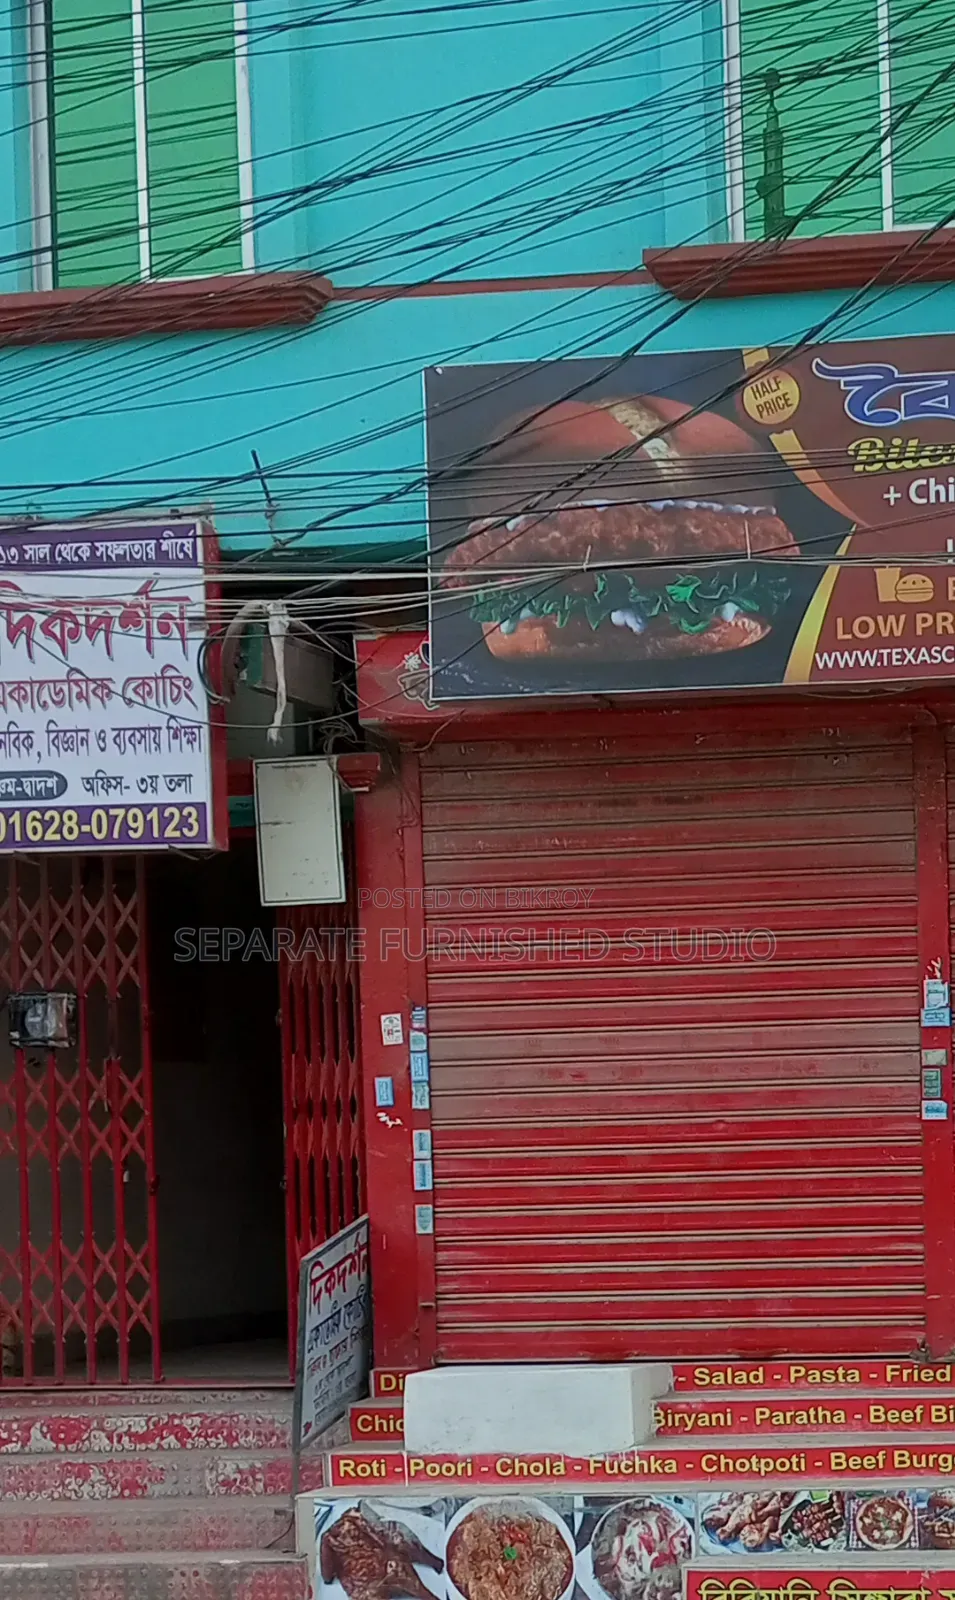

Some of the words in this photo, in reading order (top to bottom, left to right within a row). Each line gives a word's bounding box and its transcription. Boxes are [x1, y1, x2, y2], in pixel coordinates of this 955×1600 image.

[750, 374, 783, 401] HALF
[755, 396, 794, 420] PRICE
[22, 543, 51, 564] সাল
[55, 541, 92, 564] থেকে
[94, 539, 157, 562] সফলতার
[836, 614, 905, 640] LOW
[915, 611, 955, 636] PR
[121, 663, 198, 711] কোচিং
[45, 718, 91, 759] বিজ্ঞান
[95, 729, 107, 753] ও
[165, 714, 203, 754] শিক্ষা
[136, 774, 159, 796] ৩য়
[163, 773, 194, 794] তলা
[693, 1367, 764, 1386] Salad
[788, 1365, 861, 1384] Pasta
[885, 1364, 951, 1383] Fried
[653, 1408, 732, 1431] Biryani
[755, 1405, 846, 1426] Paratha
[868, 1405, 924, 1424] Beef
[339, 1458, 387, 1477] Roti
[409, 1458, 473, 1477] Poori
[495, 1456, 565, 1477] Chola
[588, 1454, 678, 1475] Fuchka
[700, 1453, 806, 1477] Chotpoti
[829, 1452, 886, 1471] Beef
[893, 1450, 955, 1473] Burg
